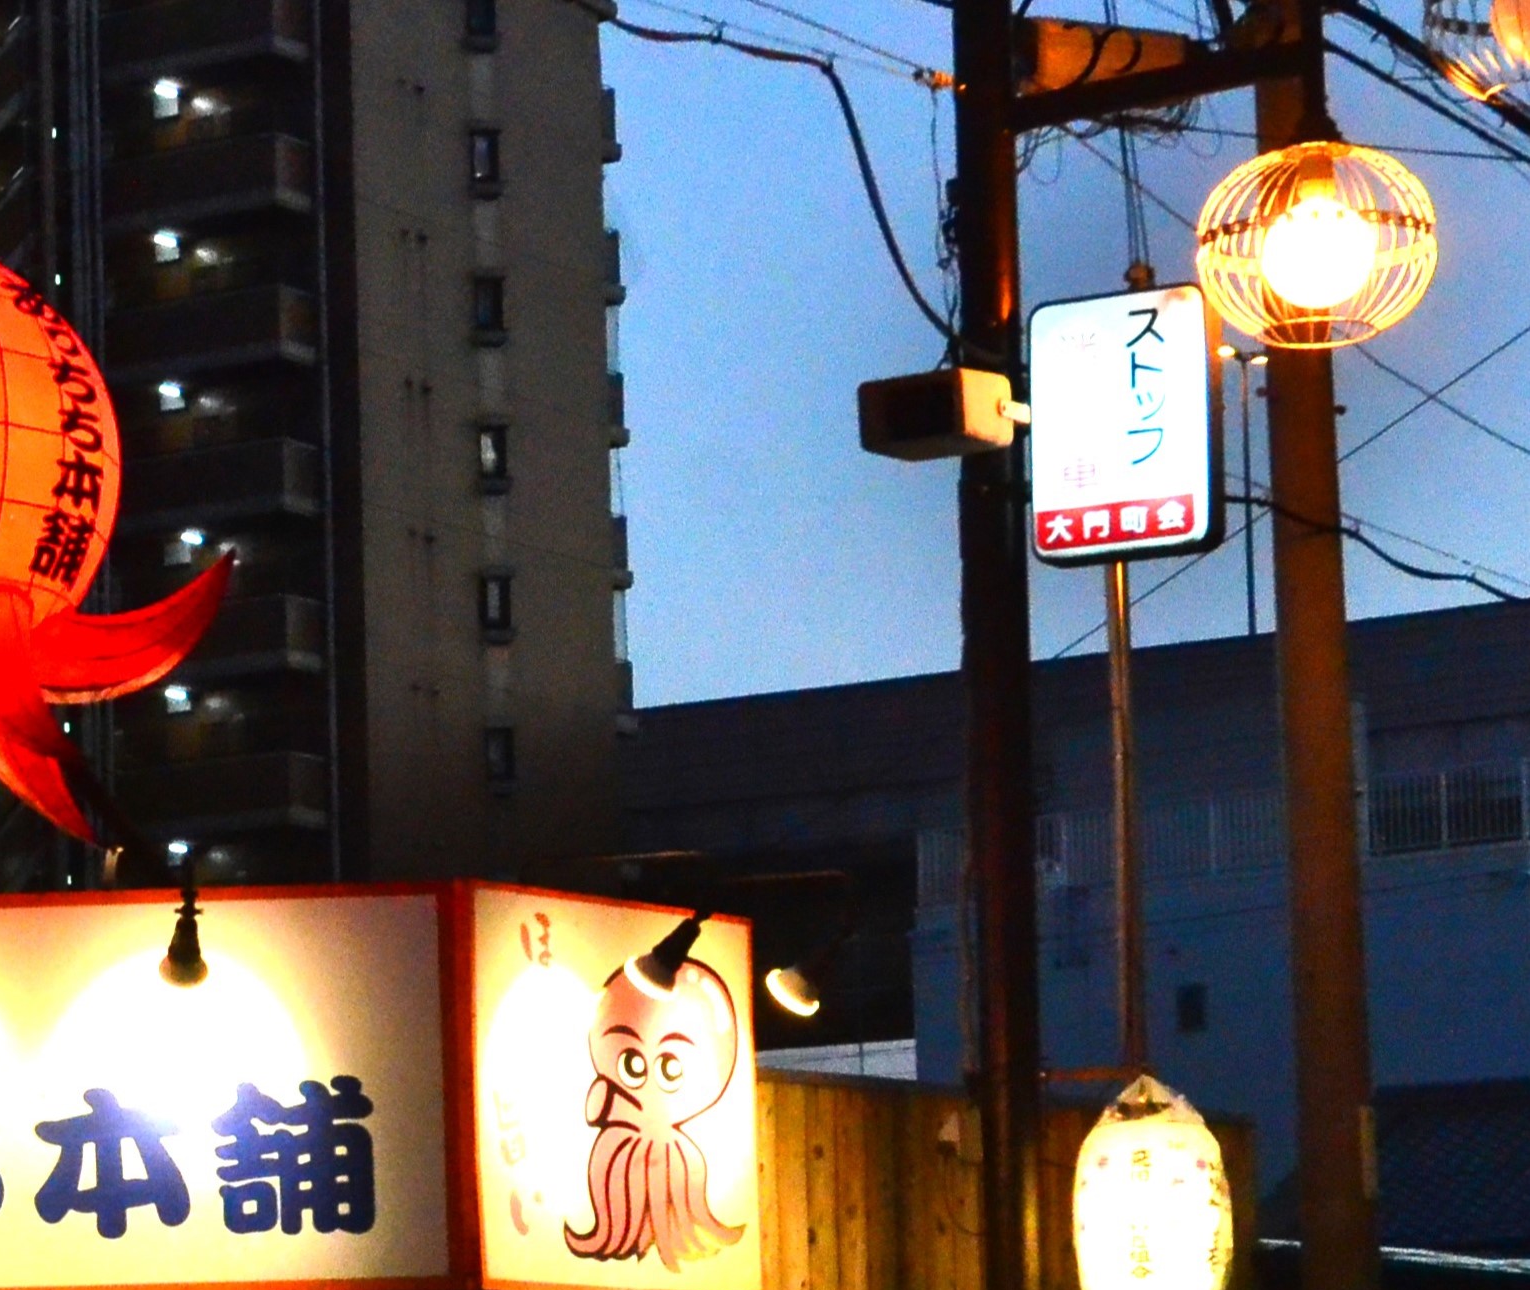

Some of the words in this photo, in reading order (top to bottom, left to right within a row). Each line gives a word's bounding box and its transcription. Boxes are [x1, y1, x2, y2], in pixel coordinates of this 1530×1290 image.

[1, 281, 104, 592] あっちち本舗
